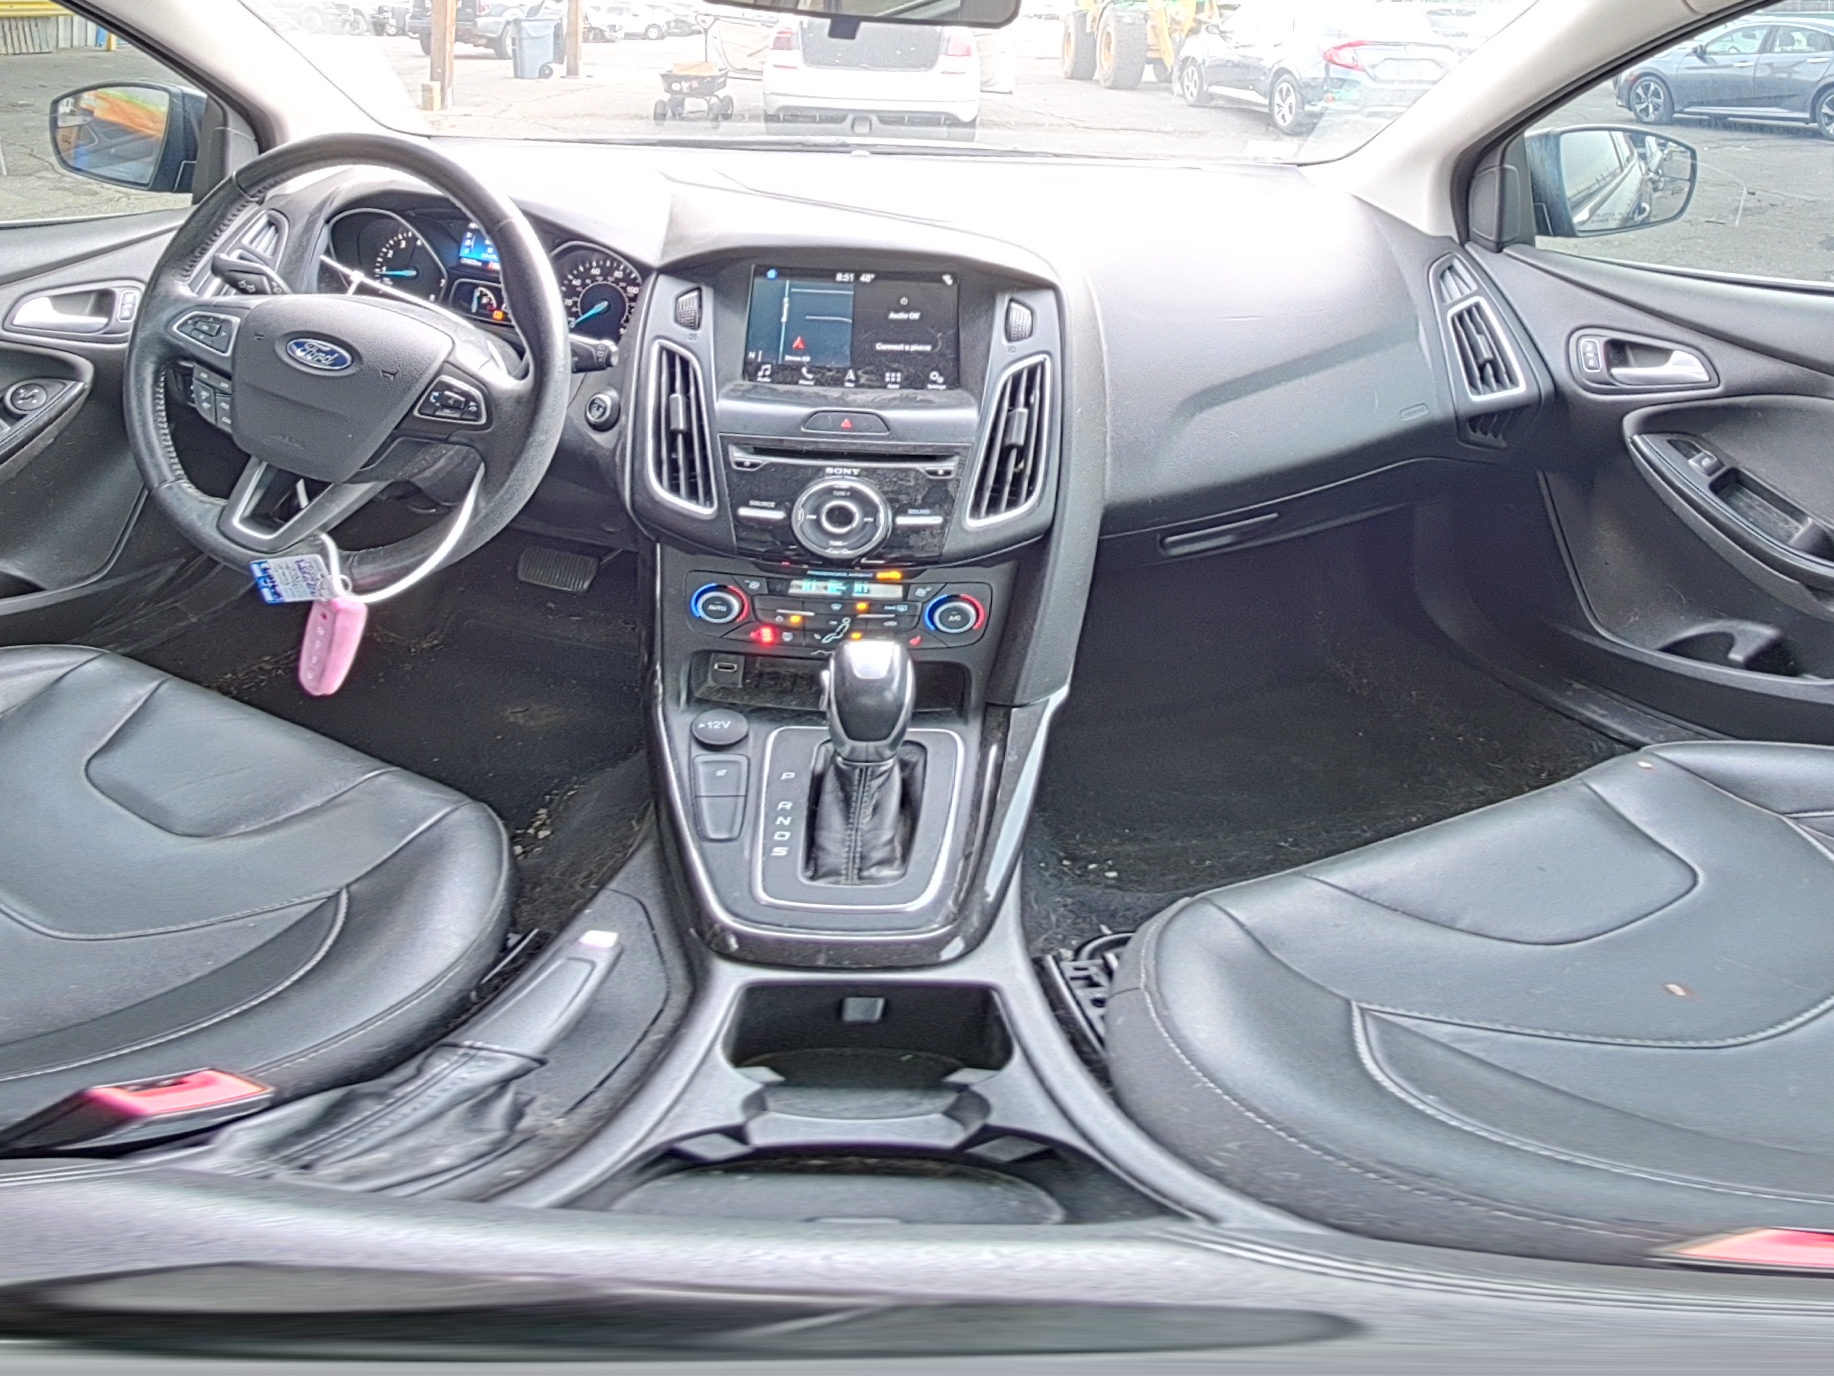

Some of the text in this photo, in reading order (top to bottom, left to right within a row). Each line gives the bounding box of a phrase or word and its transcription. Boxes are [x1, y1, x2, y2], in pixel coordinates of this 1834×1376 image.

[825, 467, 861, 476] SONY
[781, 772, 795, 780] P
[775, 816, 792, 826] N
[770, 846, 789, 857] S
